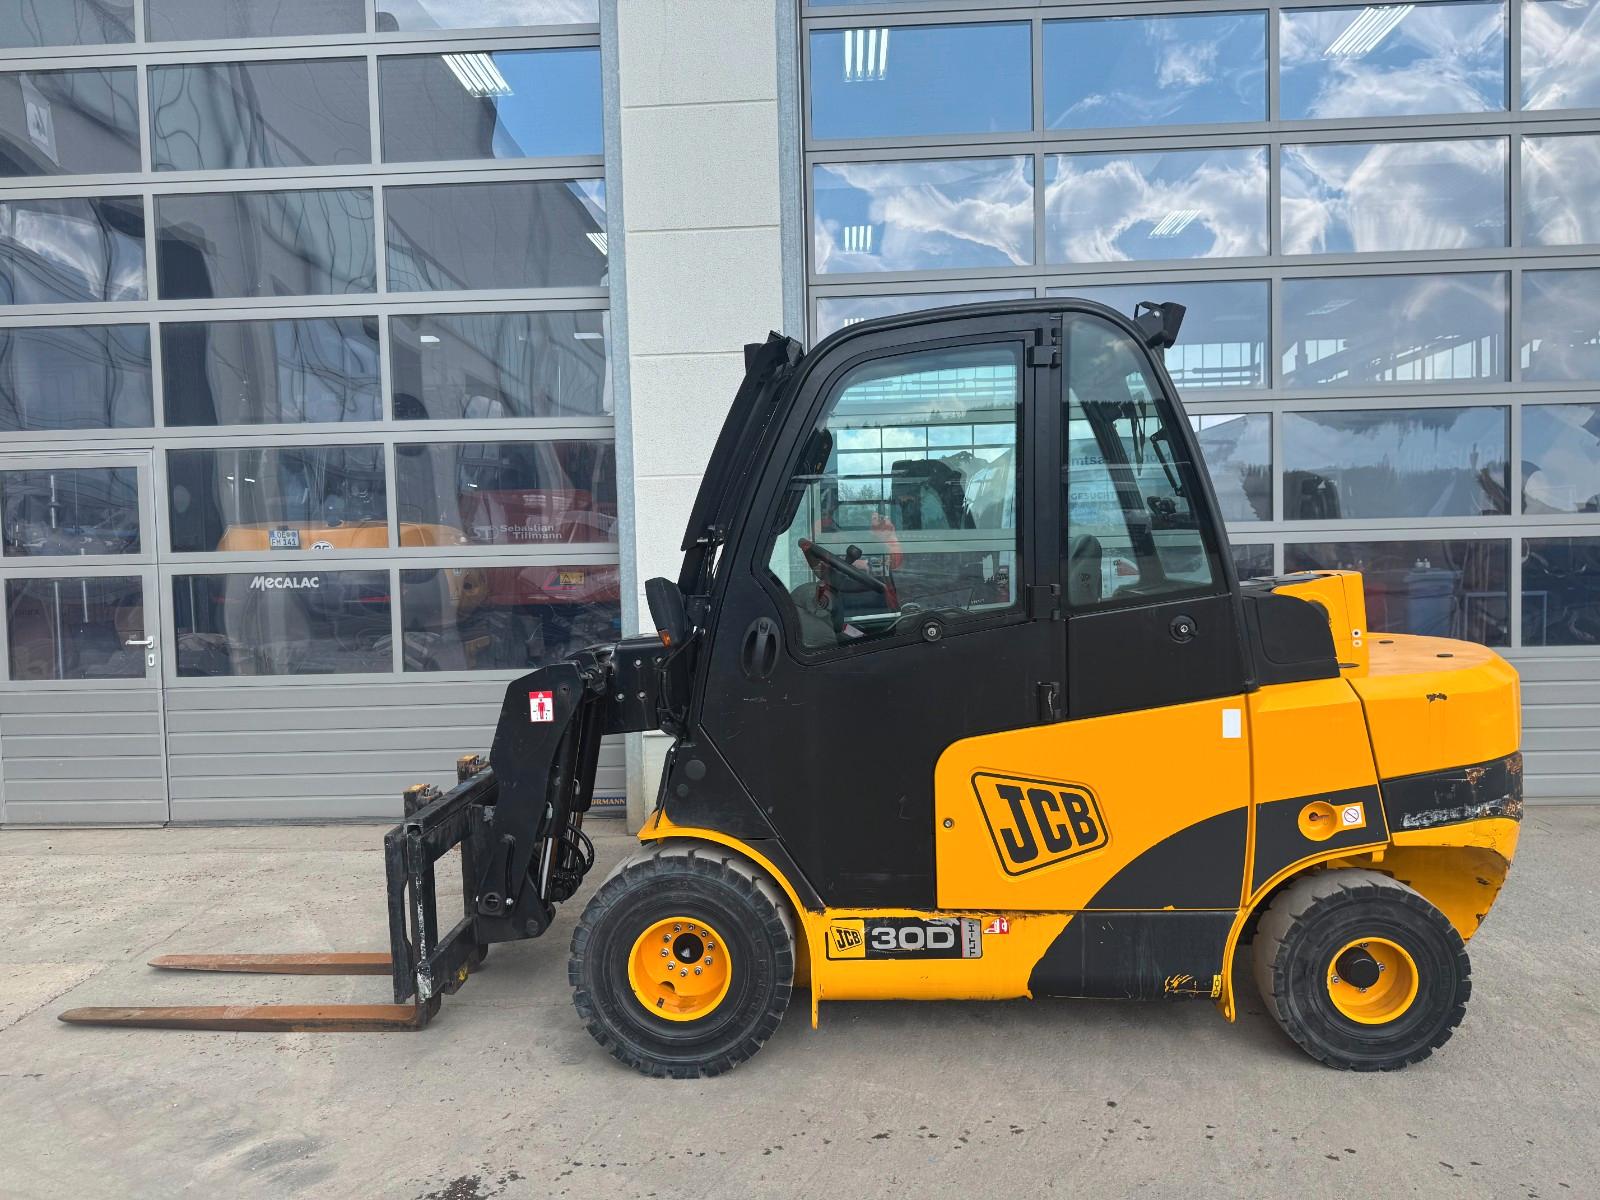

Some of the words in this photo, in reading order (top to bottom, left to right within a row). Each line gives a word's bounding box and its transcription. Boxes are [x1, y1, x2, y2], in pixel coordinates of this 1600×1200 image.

[500, 524, 554, 533] Sebastian
[513, 531, 562, 540] Tillmann
[995, 783, 1099, 864] JCB
[836, 927, 861, 949] JCB
[871, 926, 955, 950] 30D
